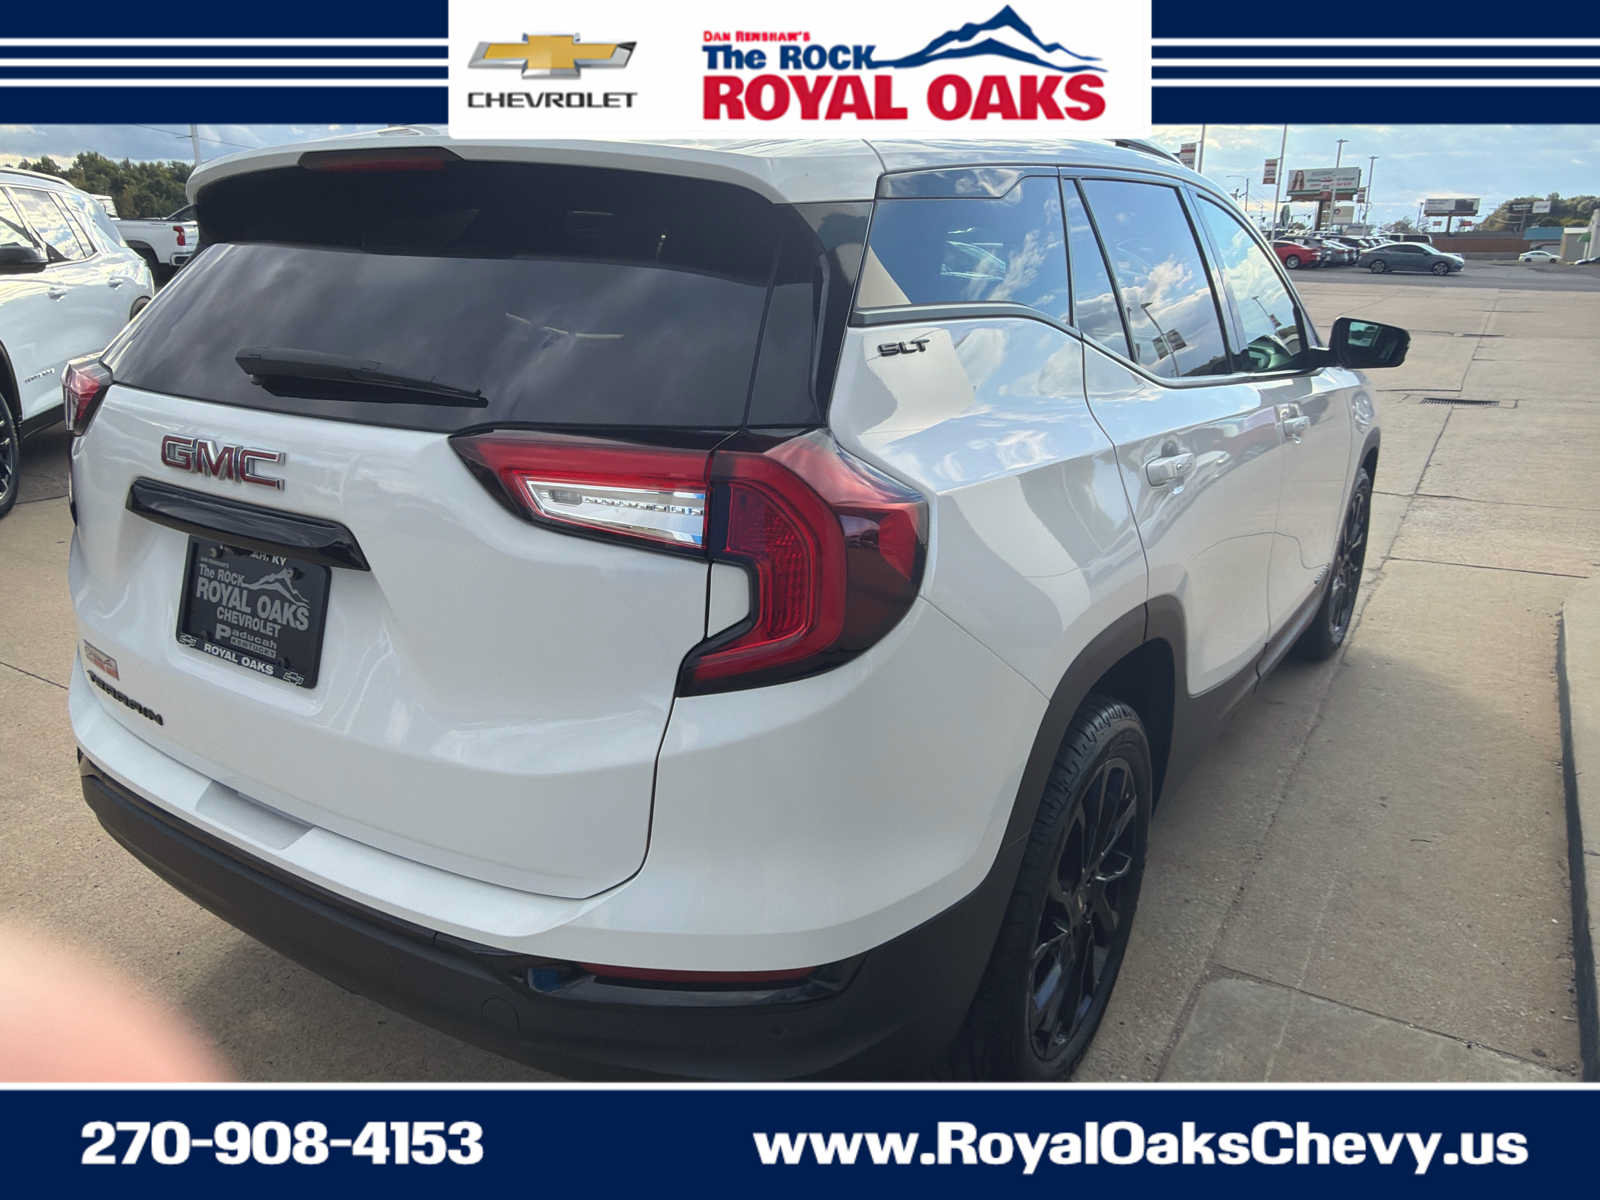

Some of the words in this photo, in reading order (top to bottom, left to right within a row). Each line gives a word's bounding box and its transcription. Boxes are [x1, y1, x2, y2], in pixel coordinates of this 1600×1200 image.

[877, 339, 930, 356] SLT
[161, 434, 286, 490] GMC
[199, 563, 216, 579] The
[217, 568, 245, 586] ROCK
[195, 576, 252, 614] ROYAL
[256, 595, 310, 631] OAKS
[216, 606, 283, 638] CHEVROLET
[203, 643, 239, 663] ROYAL
[240, 656, 275, 675] OAKS
